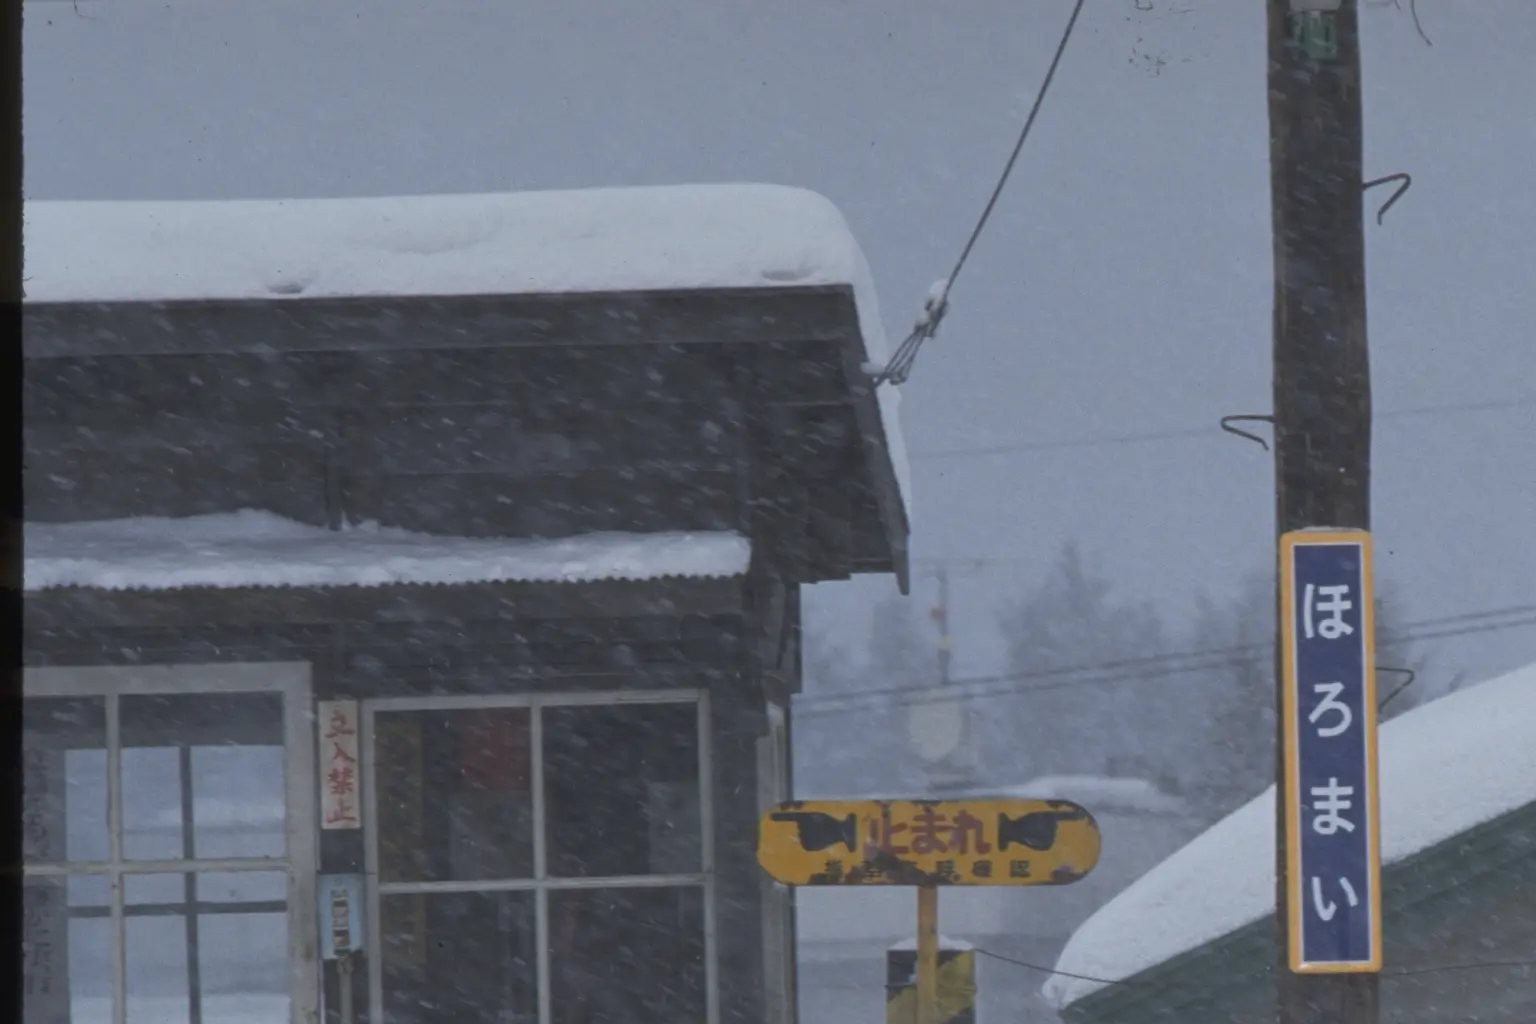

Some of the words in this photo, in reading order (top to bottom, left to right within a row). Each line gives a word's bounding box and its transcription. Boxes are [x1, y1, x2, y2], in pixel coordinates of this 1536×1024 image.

[325, 710, 356, 822] 立入禁止
[1304, 583, 1358, 922] ほろまい
[865, 808, 990, 854] 止まれ
